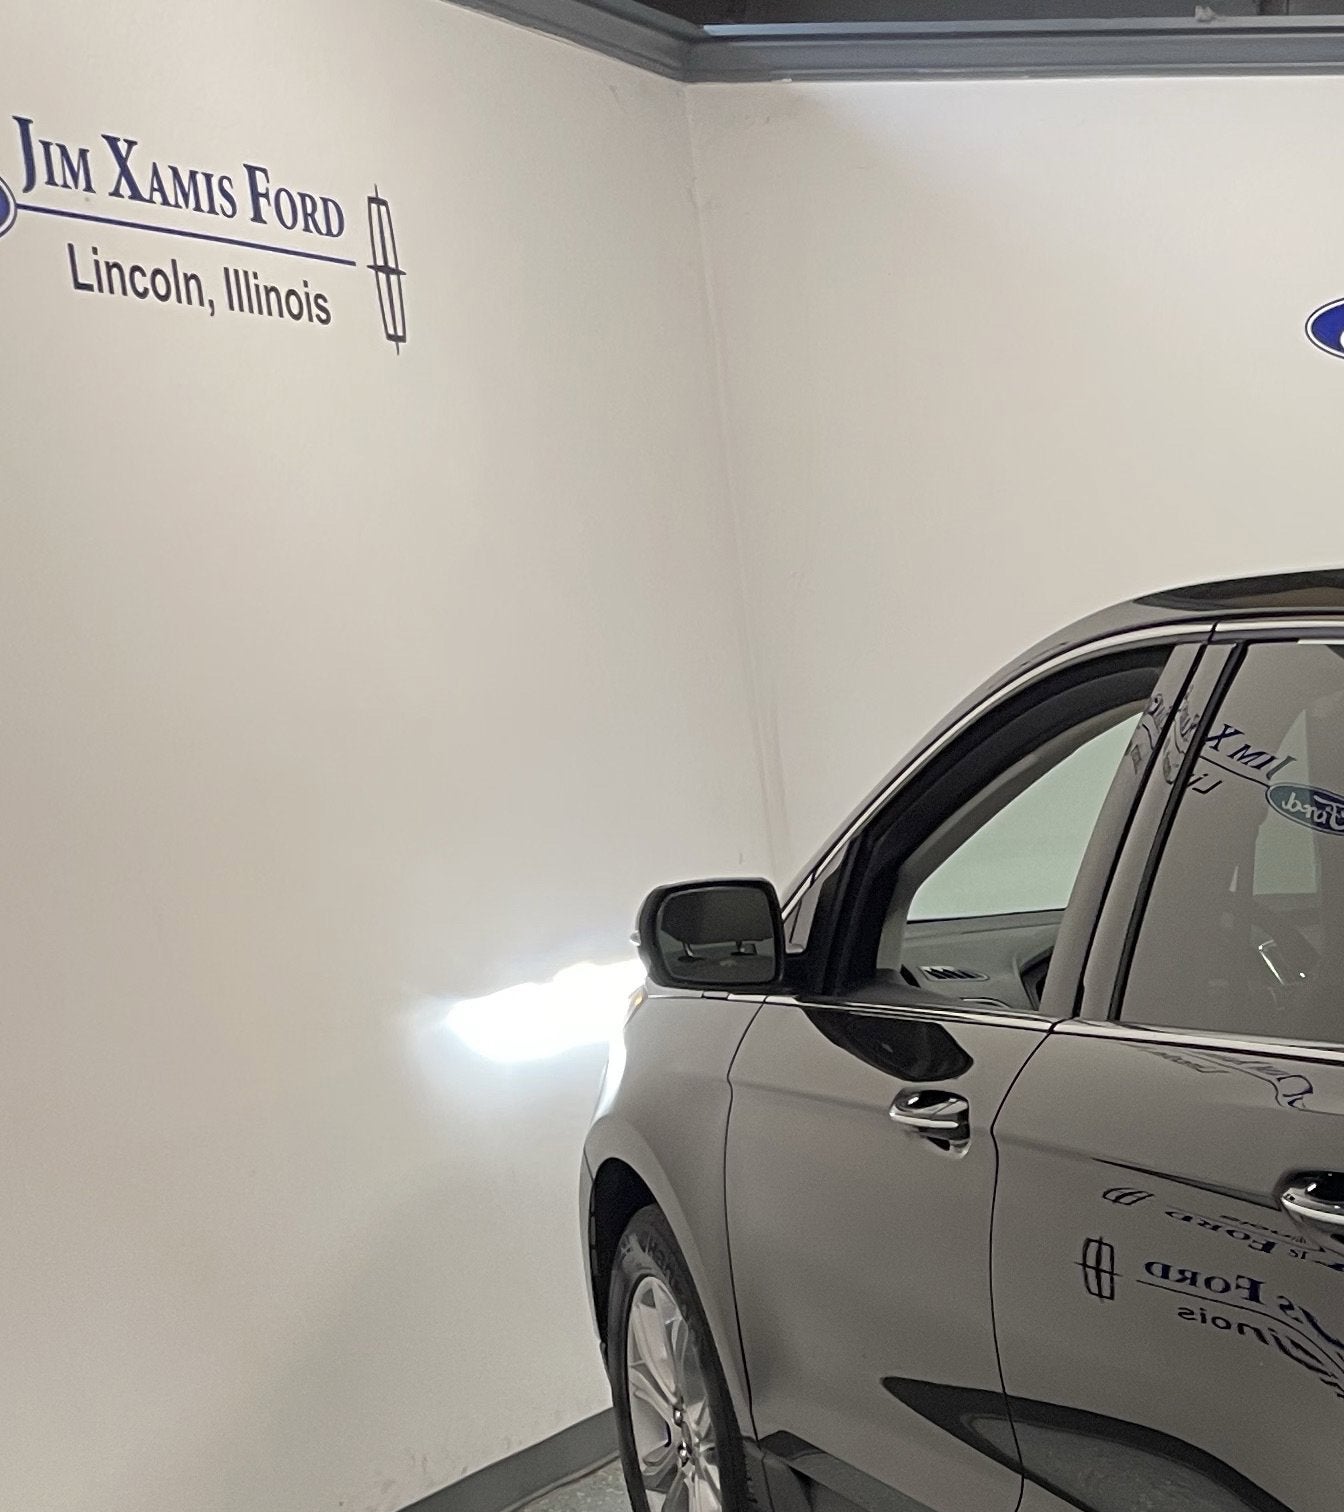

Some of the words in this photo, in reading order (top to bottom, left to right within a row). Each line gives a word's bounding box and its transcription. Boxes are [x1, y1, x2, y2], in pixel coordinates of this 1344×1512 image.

[101, 133, 239, 220] XAMIS
[242, 162, 346, 239] FORD
[66, 242, 216, 317] Lincoln,
[223, 266, 333, 326] Illinois
